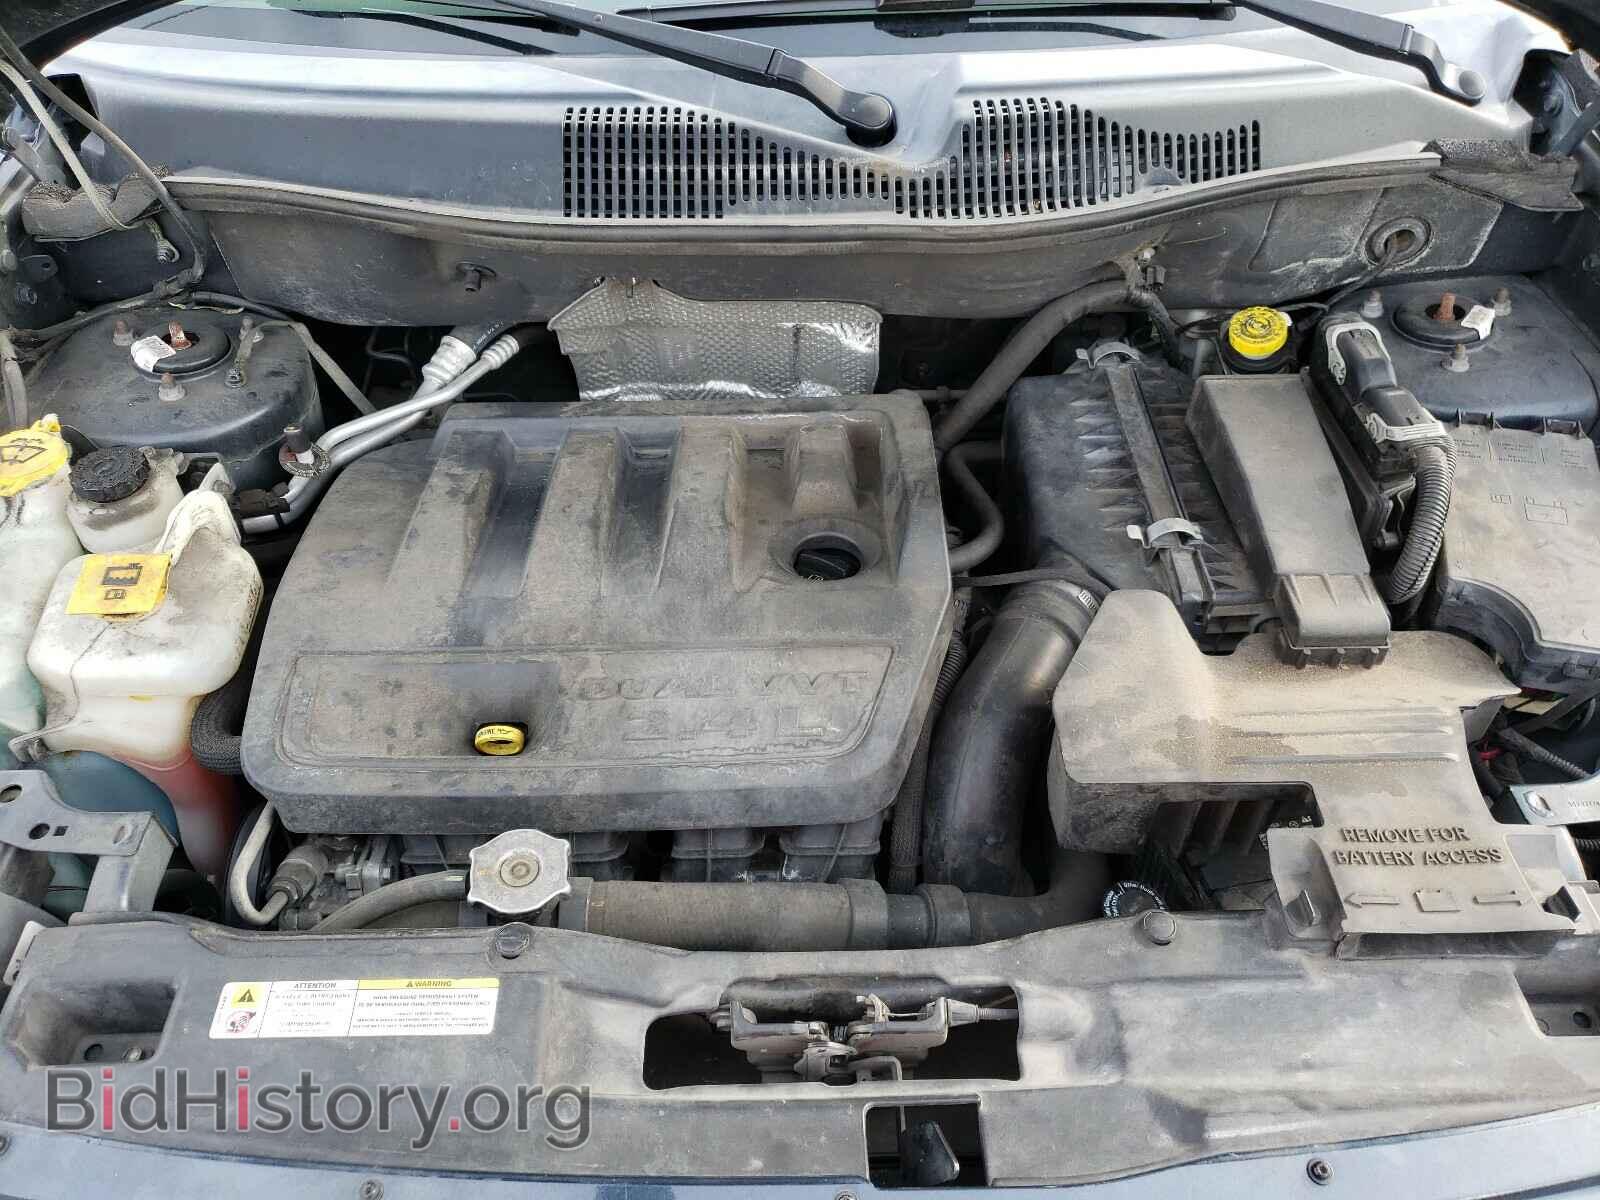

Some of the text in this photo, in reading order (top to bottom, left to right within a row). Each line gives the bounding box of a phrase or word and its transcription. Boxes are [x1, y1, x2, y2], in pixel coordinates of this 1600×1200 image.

[1340, 827, 1471, 843] REMOVE FOR
[1333, 848, 1504, 866] BATTERY ACCESS
[293, 982, 336, 990] ATTENTION
[414, 980, 452, 988] WARNING
